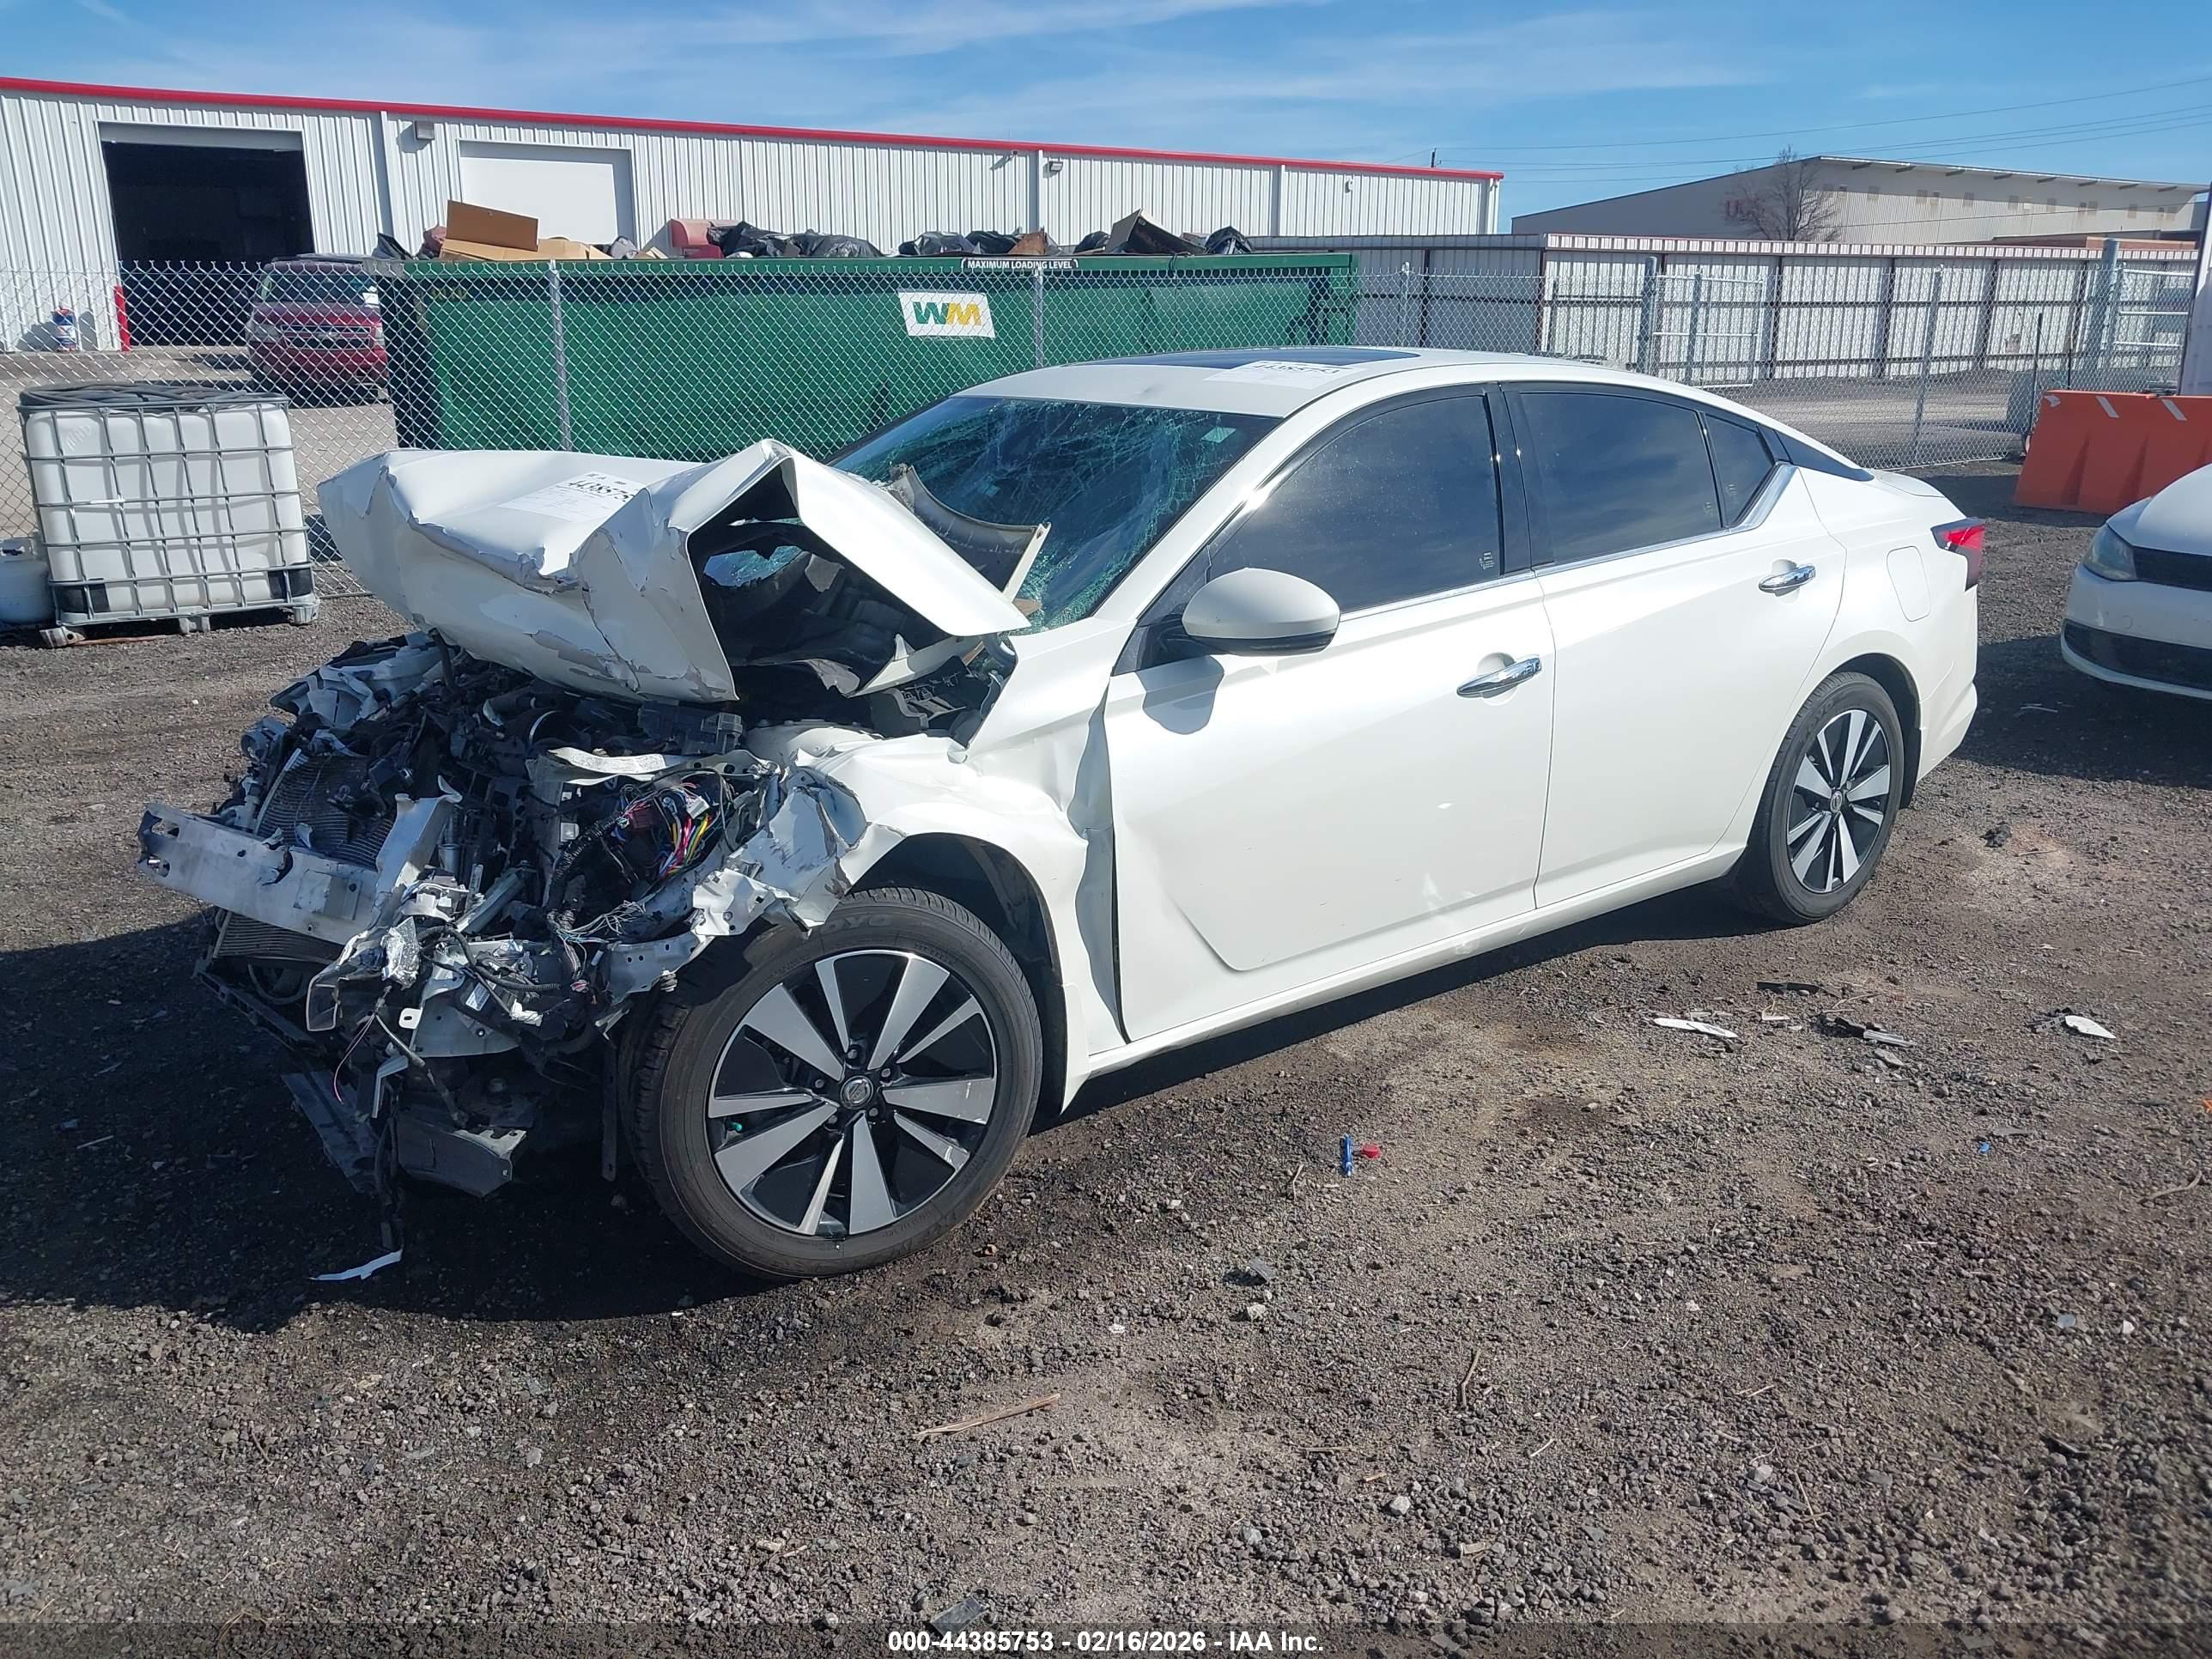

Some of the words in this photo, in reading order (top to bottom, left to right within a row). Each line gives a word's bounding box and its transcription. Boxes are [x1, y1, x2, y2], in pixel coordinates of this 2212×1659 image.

[967, 260, 1010, 270] MAXIMUM
[1011, 260, 1047, 270] LOADING
[1048, 260, 1073, 270] LEVEL
[913, 301, 981, 326] WM
[820, 914, 894, 935] OYO
